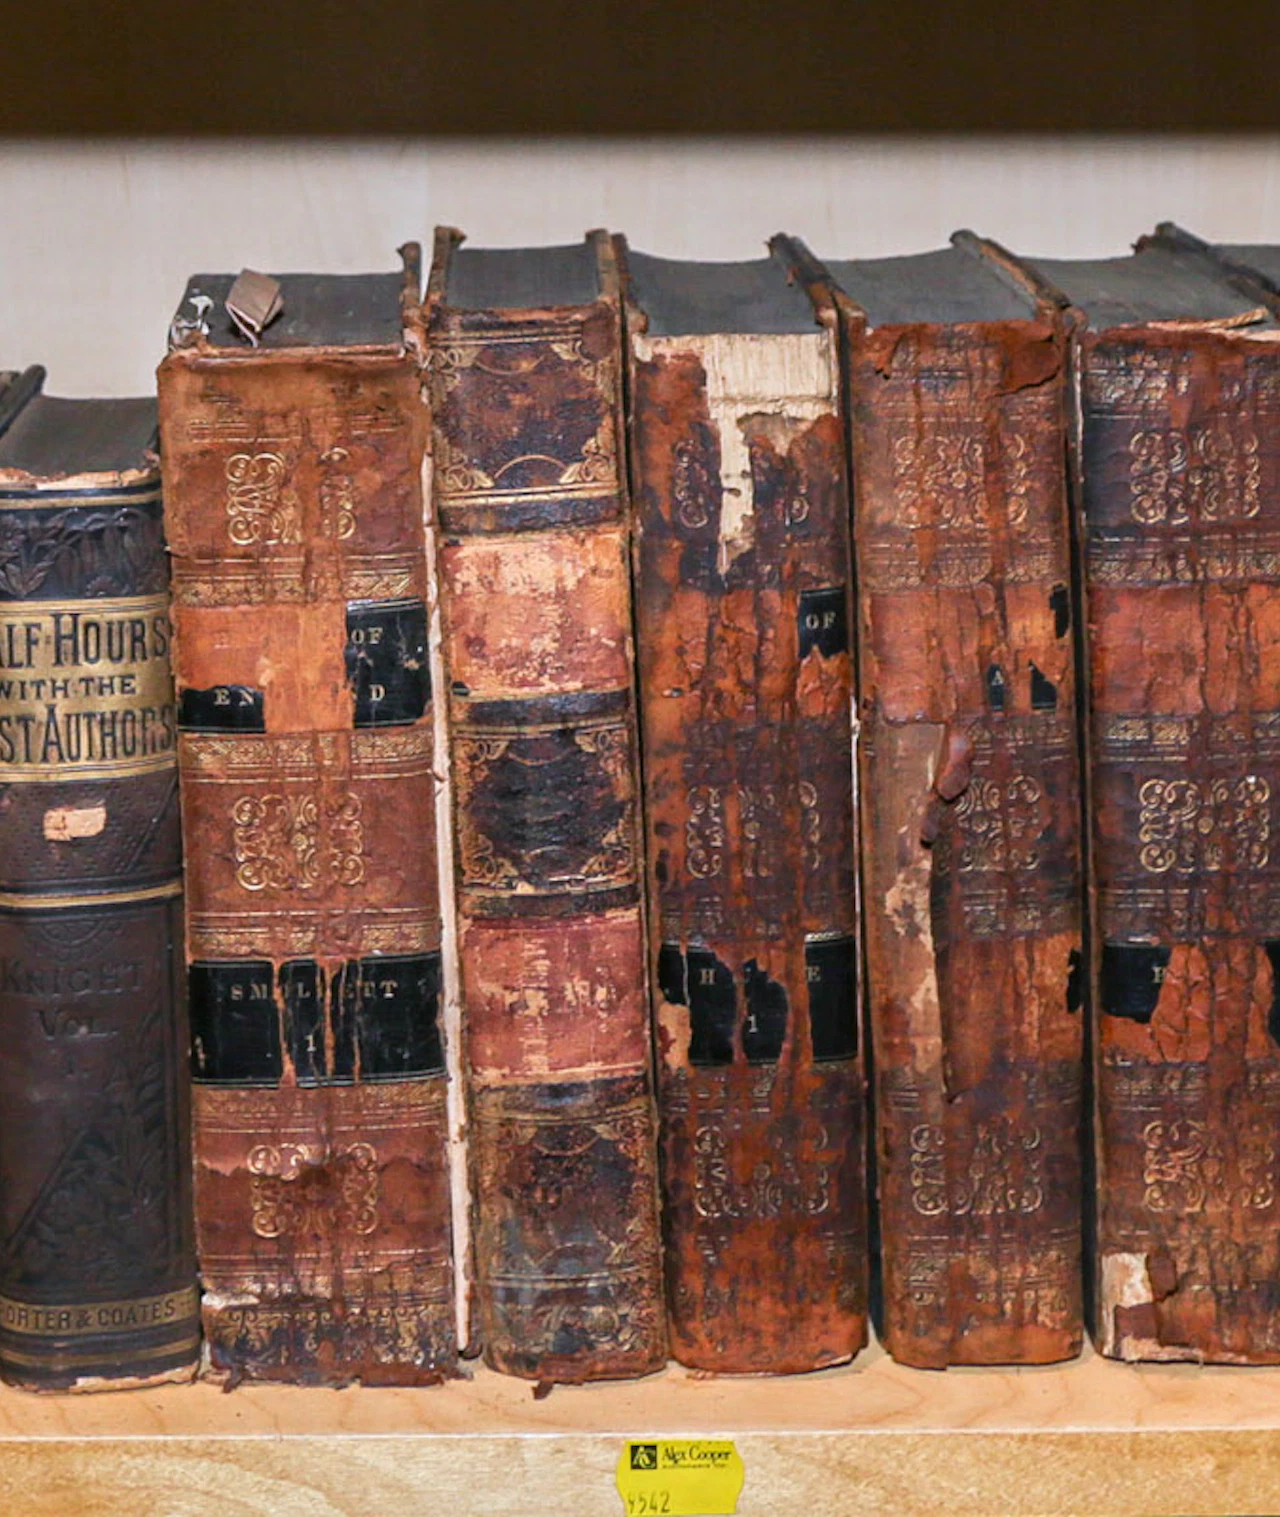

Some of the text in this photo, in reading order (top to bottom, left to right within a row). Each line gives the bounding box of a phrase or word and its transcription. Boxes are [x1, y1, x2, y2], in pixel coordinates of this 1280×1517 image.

[806, 611, 837, 630] OF
[51, 612, 168, 667] HOURS
[350, 626, 383, 646] OF
[79, 674, 136, 697] THE
[41, 703, 175, 763] AUTHORS
[2, 961, 143, 997] KNIGHT
[5, 1298, 176, 1330] ORTER & COATES
[662, 1446, 687, 1464] Alex
[689, 1445, 731, 1464] Cooper
